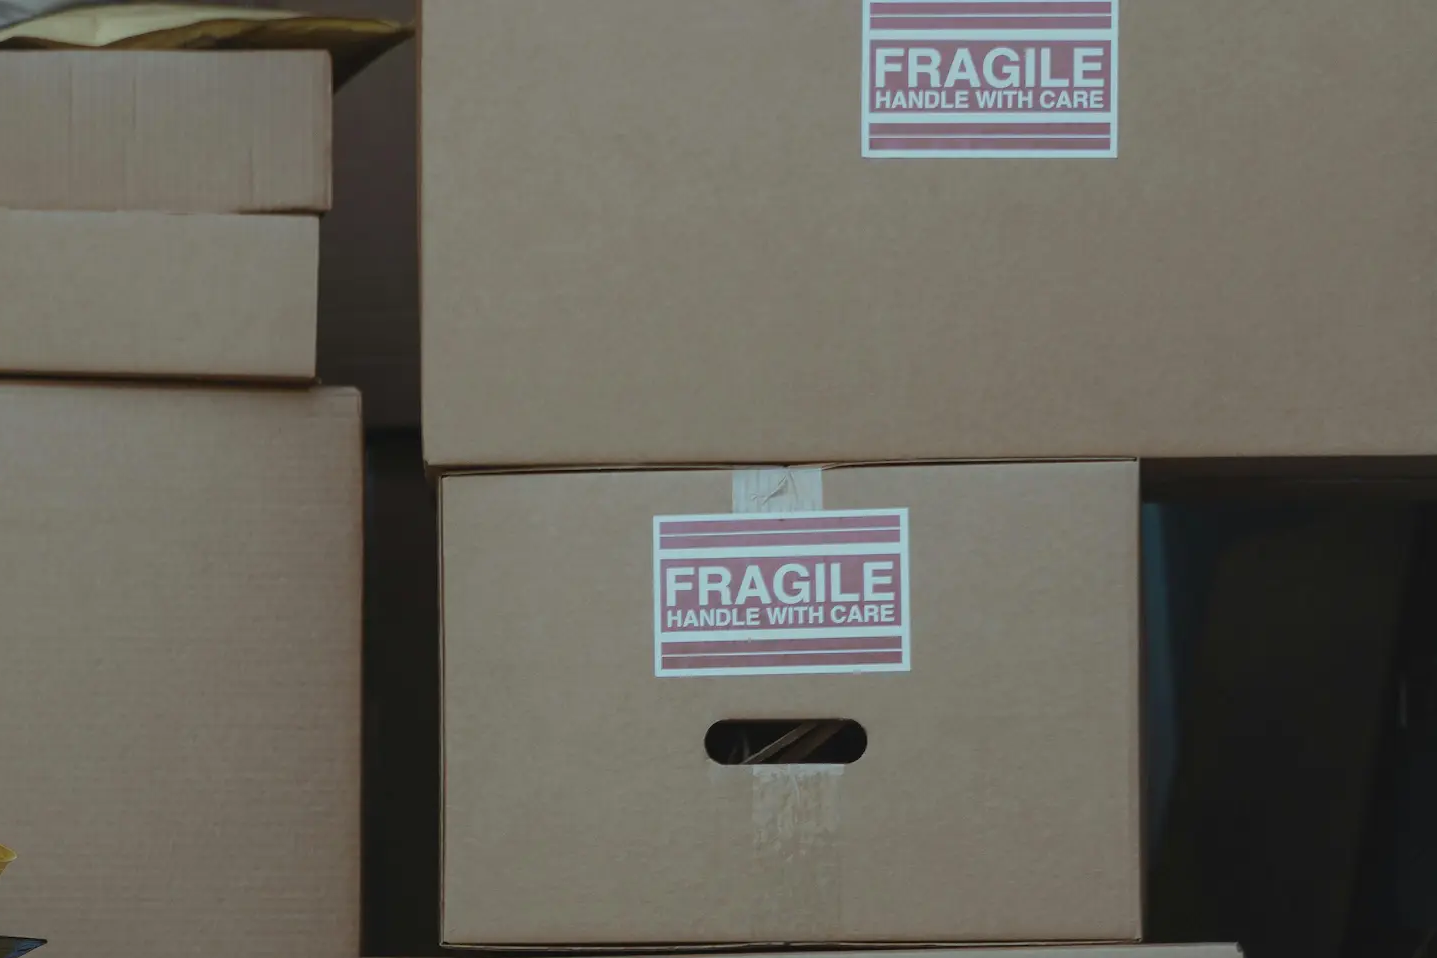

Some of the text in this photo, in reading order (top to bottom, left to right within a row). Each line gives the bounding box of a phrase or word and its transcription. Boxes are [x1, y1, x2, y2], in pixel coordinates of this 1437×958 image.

[874, 47, 1105, 88] FRAGILE
[875, 89, 1105, 109] HANDLE WITH CARE
[665, 561, 895, 607] FRAGILE
[666, 604, 895, 628] HANDLE WITH CARE
